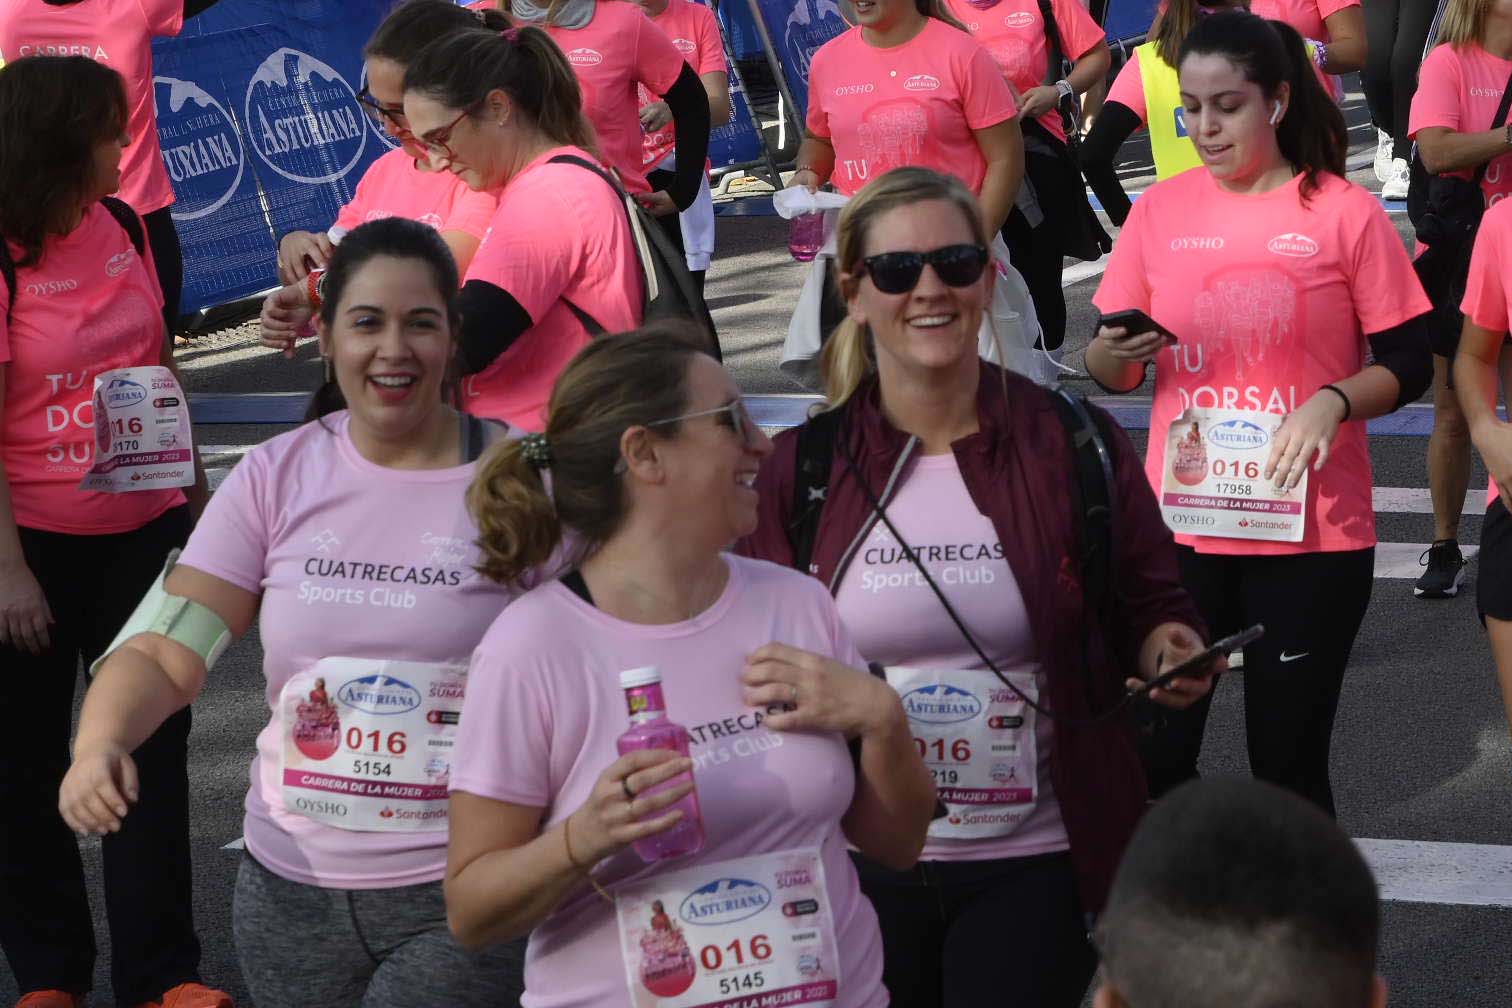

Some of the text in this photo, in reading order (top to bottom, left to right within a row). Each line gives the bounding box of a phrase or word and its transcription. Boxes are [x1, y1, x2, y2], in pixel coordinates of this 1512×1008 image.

[835, 83, 874, 96] OYSHO
[257, 104, 361, 156] ASTURIANA
[843, 159, 868, 180] TU
[1170, 236, 1225, 251] OYSHO
[1271, 239, 1315, 253] ASTURIANA
[26, 278, 78, 296] OYSHO
[1170, 343, 1203, 374] TU
[46, 370, 88, 394] TU
[151, 382, 175, 390] SUMA
[1211, 428, 1266, 443] ASTURIANA
[132, 454, 159, 463] MUJER
[142, 469, 185, 481] Santander
[1211, 458, 1260, 479] 016
[1215, 482, 1253, 496] 17958
[1177, 495, 1216, 508] CARRERA
[1217, 498, 1229, 509] DE
[1230, 499, 1241, 509] LA
[1242, 500, 1270, 511] MUJER
[1172, 512, 1293, 530] OYSHO Santander
[304, 557, 462, 586] CUATRECASAS
[942, 565, 996, 585] Club
[297, 580, 417, 609] Sports Club
[345, 687, 415, 708] ASTURIANA
[905, 698, 976, 714] ASTURIANA
[346, 727, 408, 755] 016
[733, 732, 784, 758] Club
[353, 759, 392, 777] 5154
[301, 775, 348, 791] CARRERA
[350, 781, 366, 793] DE
[367, 783, 382, 796] LA
[384, 785, 422, 797] MUJER
[952, 789, 989, 801] MUJER
[295, 797, 349, 817] OYSHO
[962, 812, 1024, 826] Santander
[686, 894, 766, 921] ASTURIANA
[700, 933, 773, 971] 016
[719, 971, 766, 995] 5145
[760, 987, 804, 1004] MUJER
